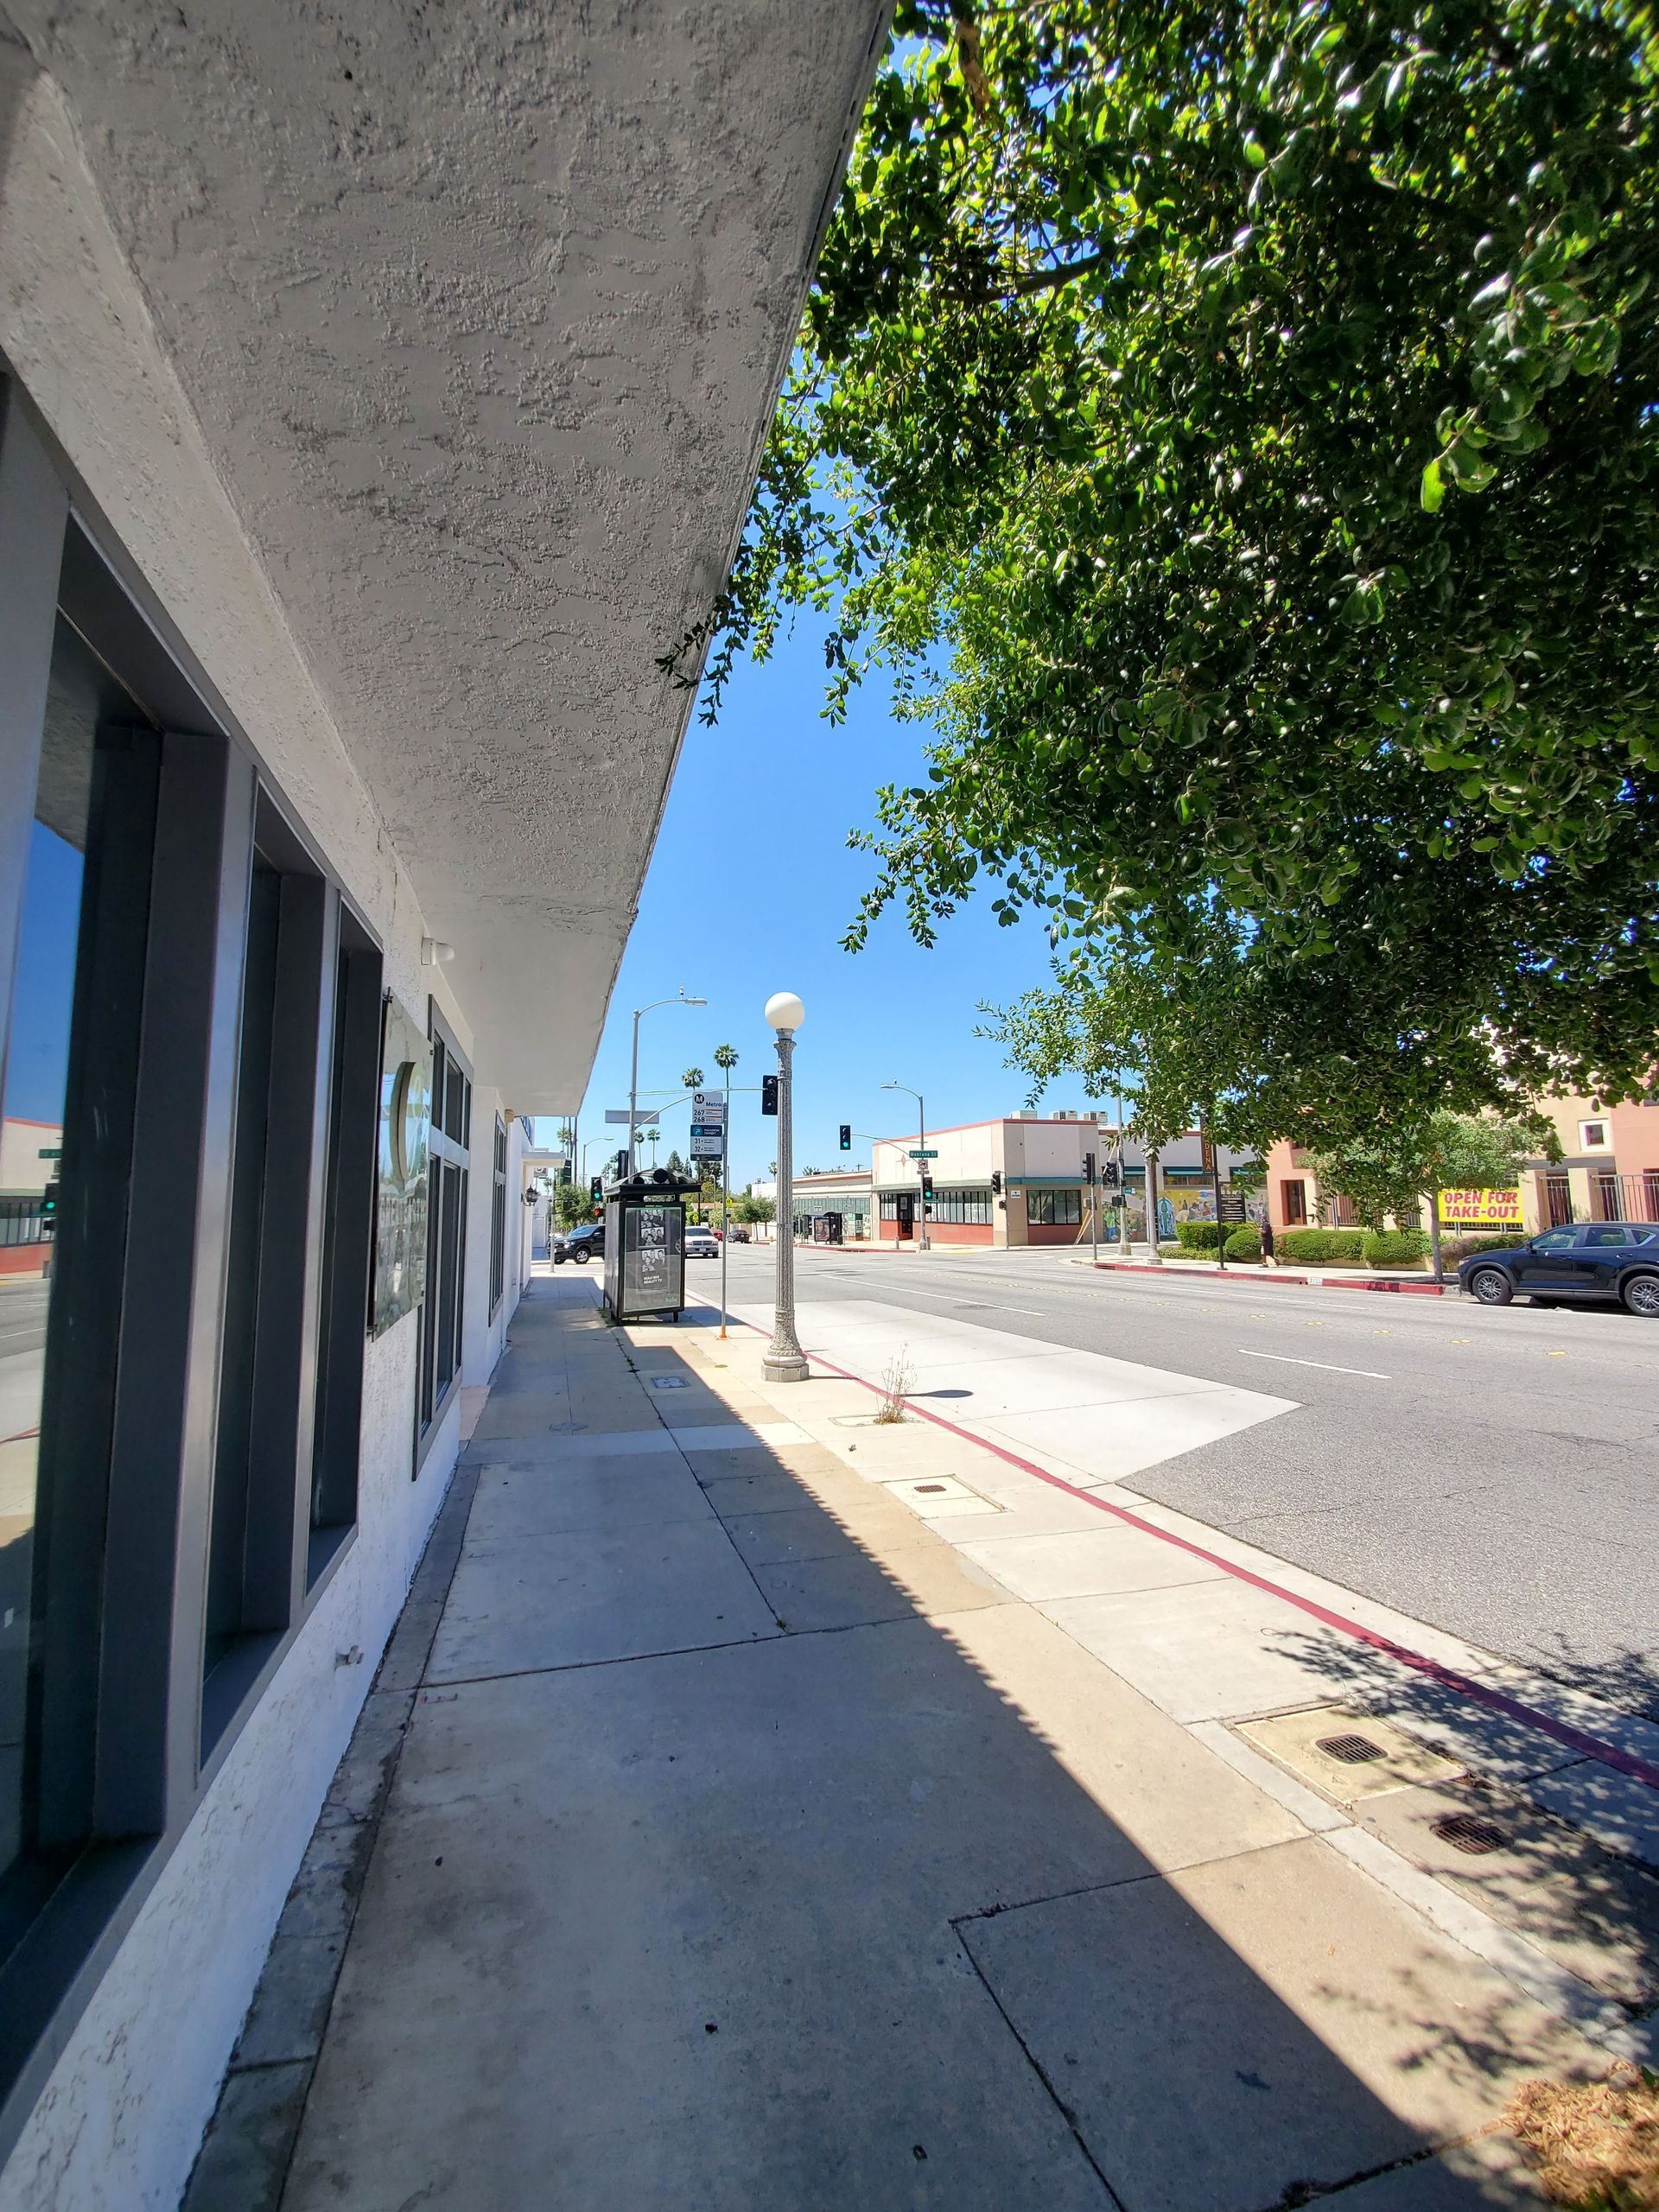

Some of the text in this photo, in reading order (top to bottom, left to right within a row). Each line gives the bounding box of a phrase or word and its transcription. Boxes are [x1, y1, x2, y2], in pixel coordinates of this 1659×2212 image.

[1444, 1192, 1518, 1204] OPEN FOR
[1445, 1206, 1519, 1217] TAKE-OUT
